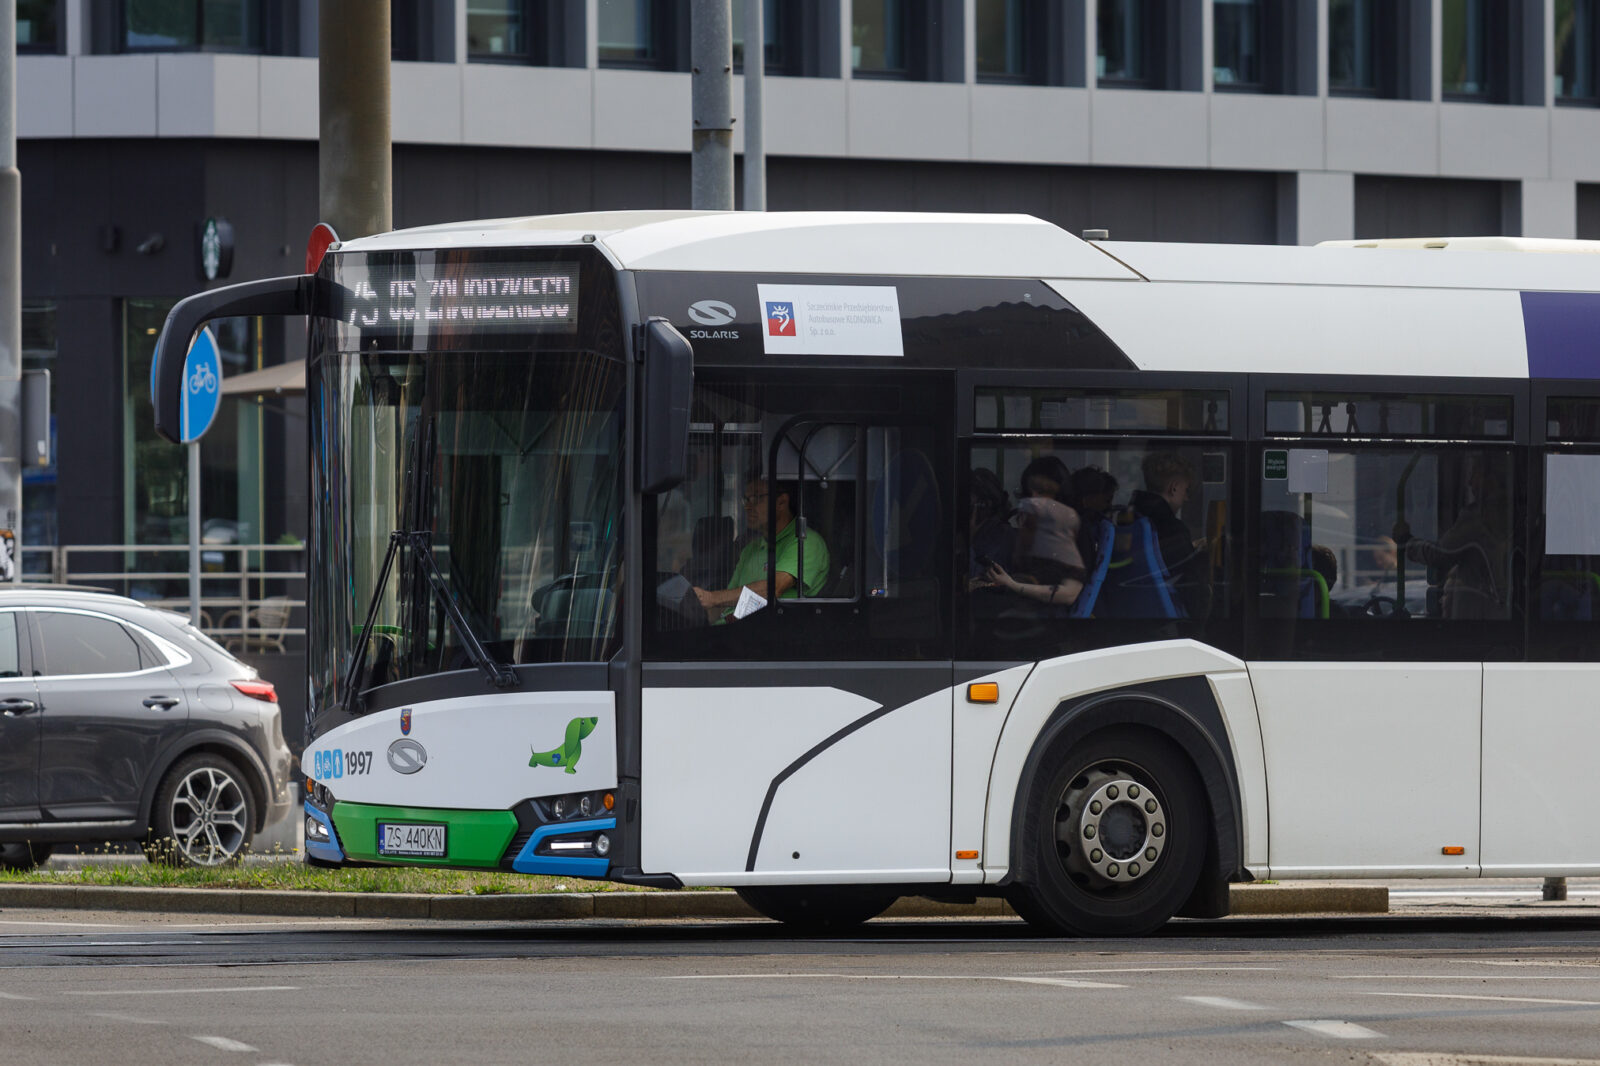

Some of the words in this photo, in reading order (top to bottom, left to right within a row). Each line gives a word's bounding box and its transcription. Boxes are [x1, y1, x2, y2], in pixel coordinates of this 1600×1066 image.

[690, 330, 739, 339] SOLARIS
[344, 751, 373, 775] 1997
[387, 827, 402, 848] ZS
[406, 828, 442, 850] 440KN
